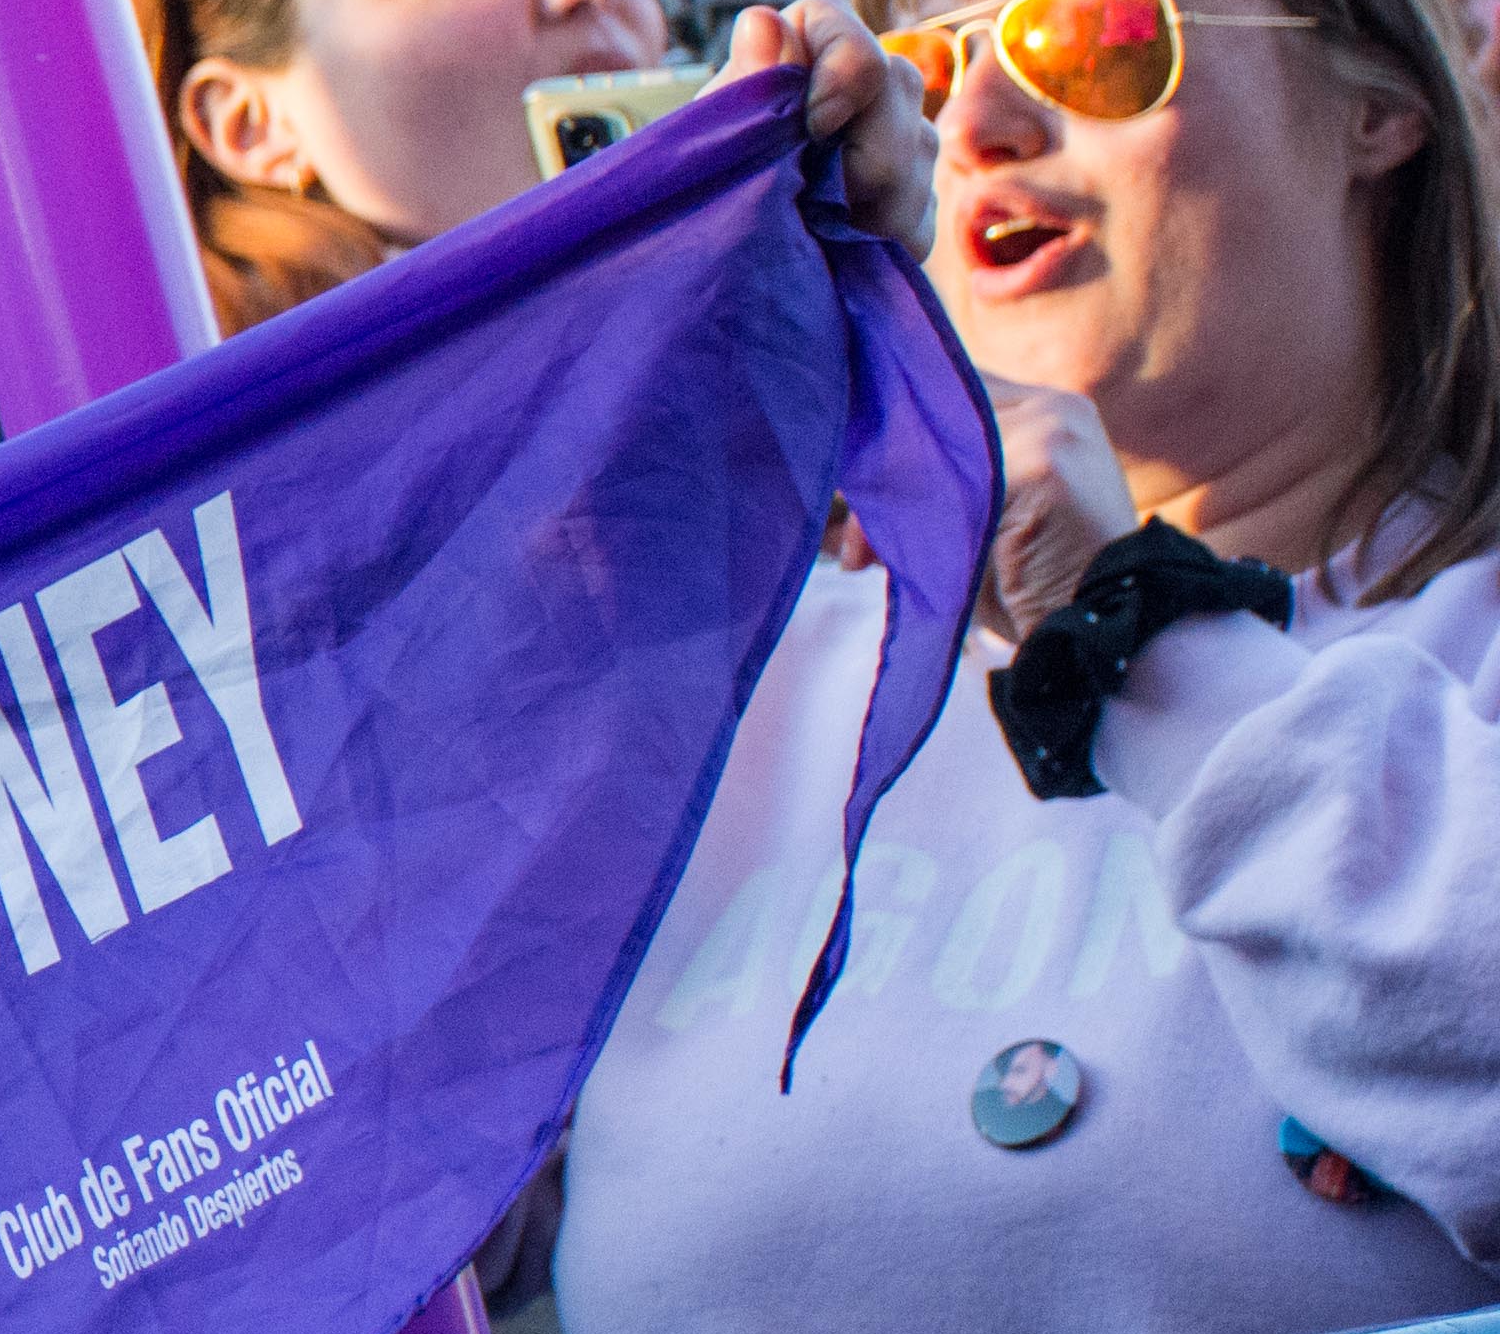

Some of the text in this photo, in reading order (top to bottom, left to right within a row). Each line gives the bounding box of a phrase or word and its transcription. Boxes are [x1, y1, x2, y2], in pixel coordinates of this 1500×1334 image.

[80, 1158, 131, 1229] de
[121, 1119, 221, 1204] Fans
[215, 1039, 334, 1153] Oficial
[92, 1148, 303, 1289] Soñando Despiertos
